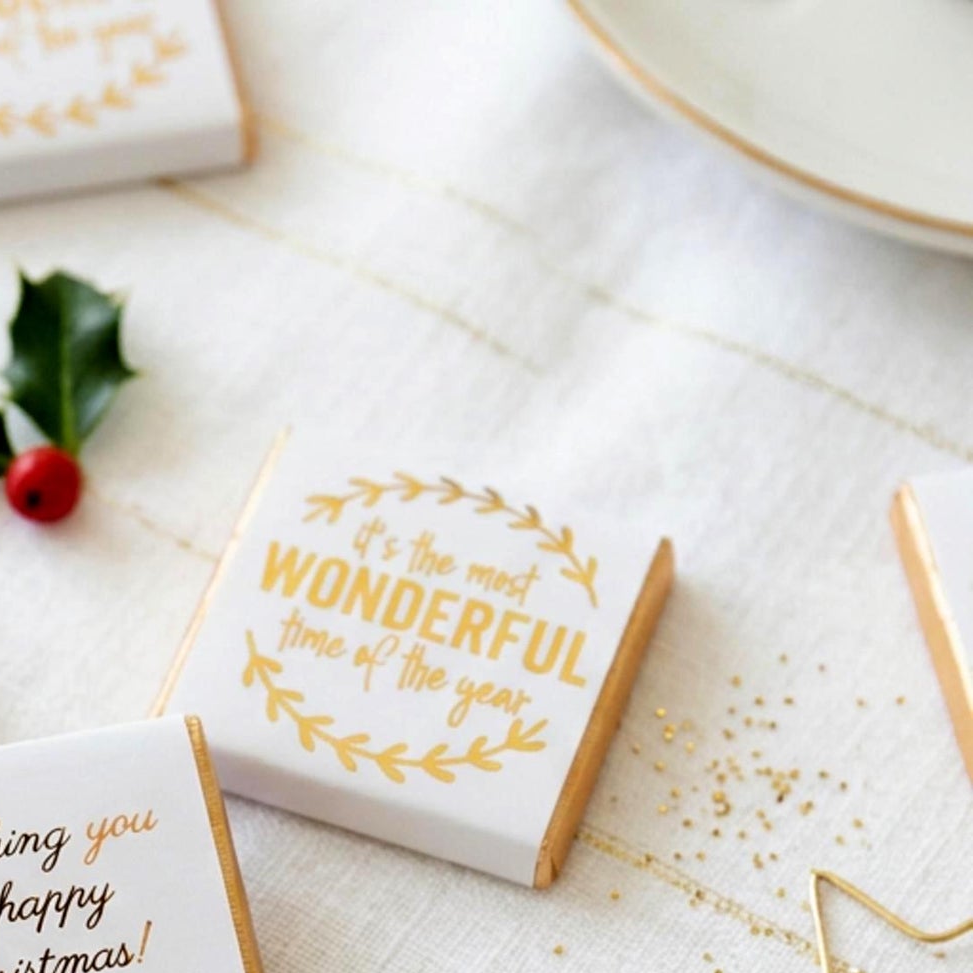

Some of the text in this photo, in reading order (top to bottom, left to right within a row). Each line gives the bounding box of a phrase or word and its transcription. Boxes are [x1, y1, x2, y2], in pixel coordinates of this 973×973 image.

[353, 517, 541, 605] it's the most
[260, 540, 588, 689] WONDERFUL
[278, 607, 532, 728] time of the year
[84, 809, 158, 865] you
